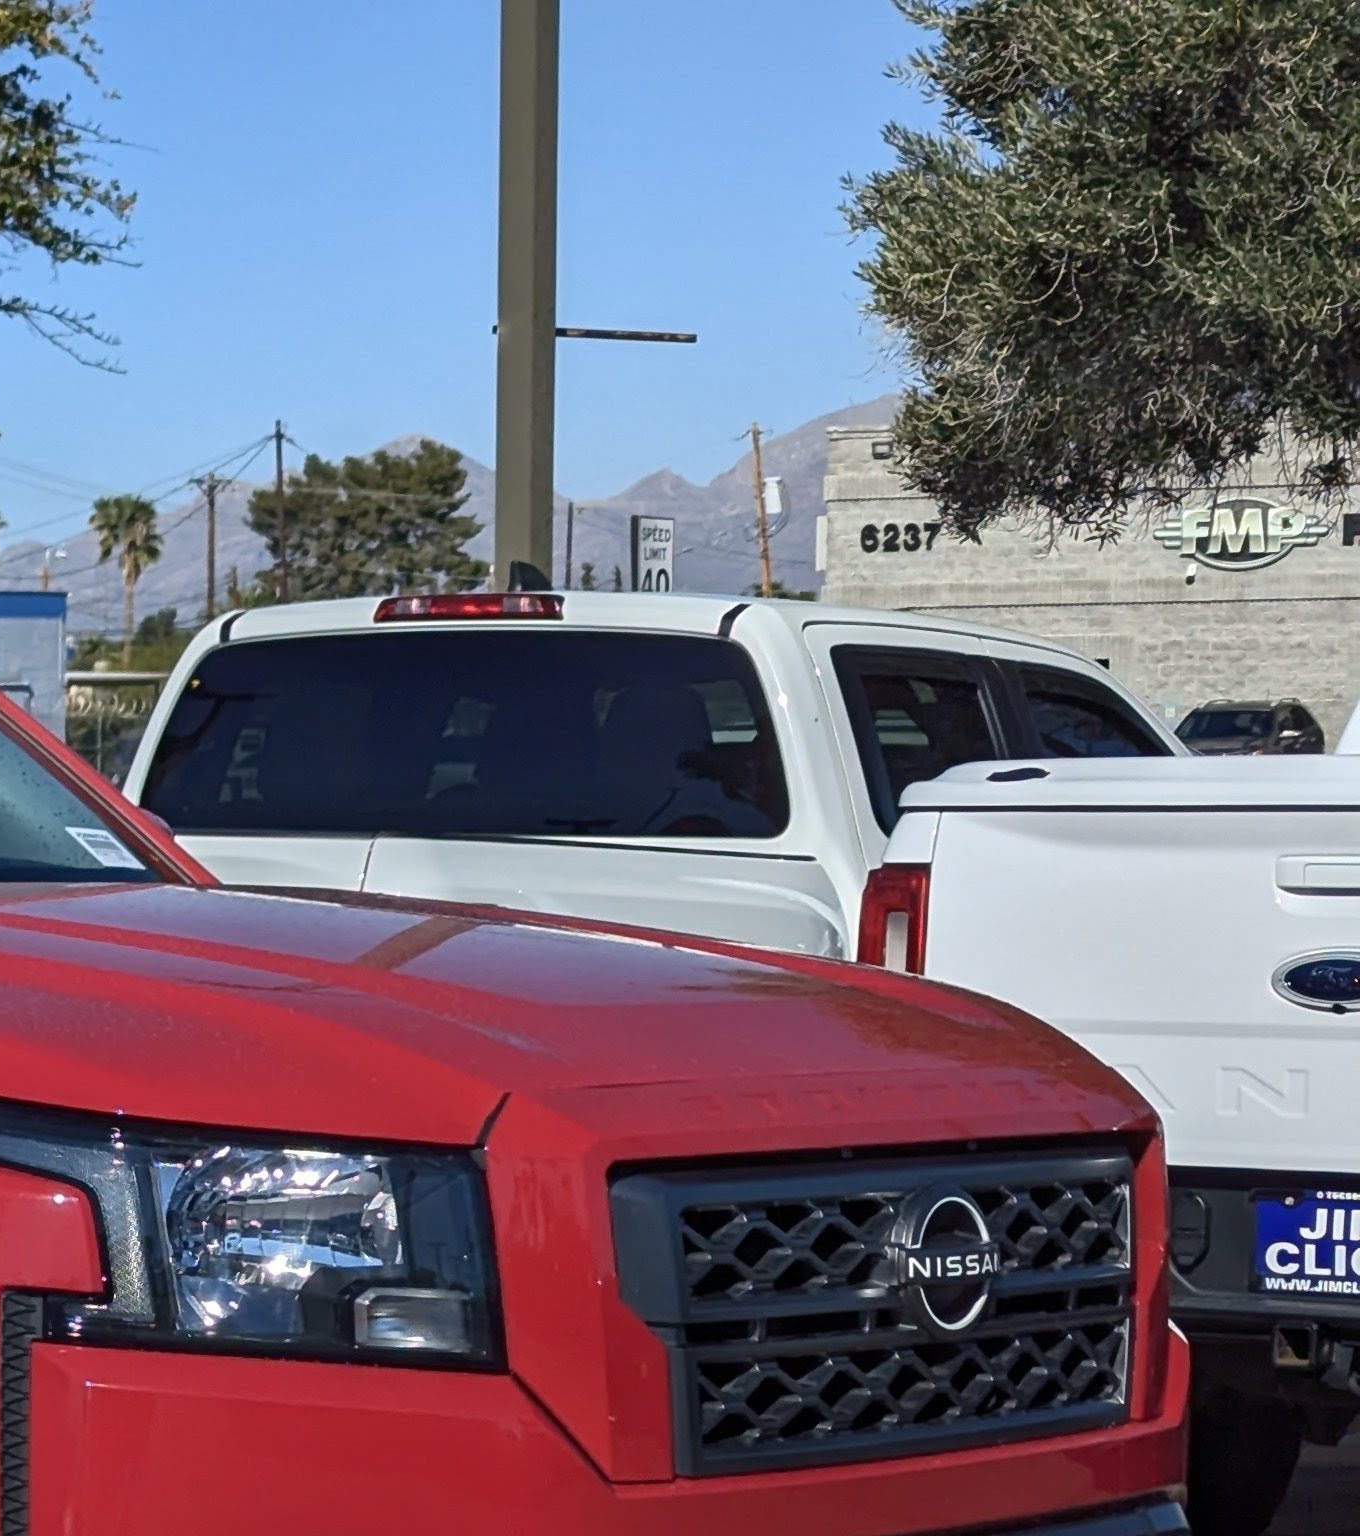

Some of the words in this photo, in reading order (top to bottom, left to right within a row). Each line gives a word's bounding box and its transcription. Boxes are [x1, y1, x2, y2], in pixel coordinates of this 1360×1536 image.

[641, 526, 671, 543] SPEED
[860, 522, 940, 553] 6237
[1180, 506, 1306, 555] FMP
[643, 546, 668, 561] LIMIT
[640, 568, 670, 592] 40
